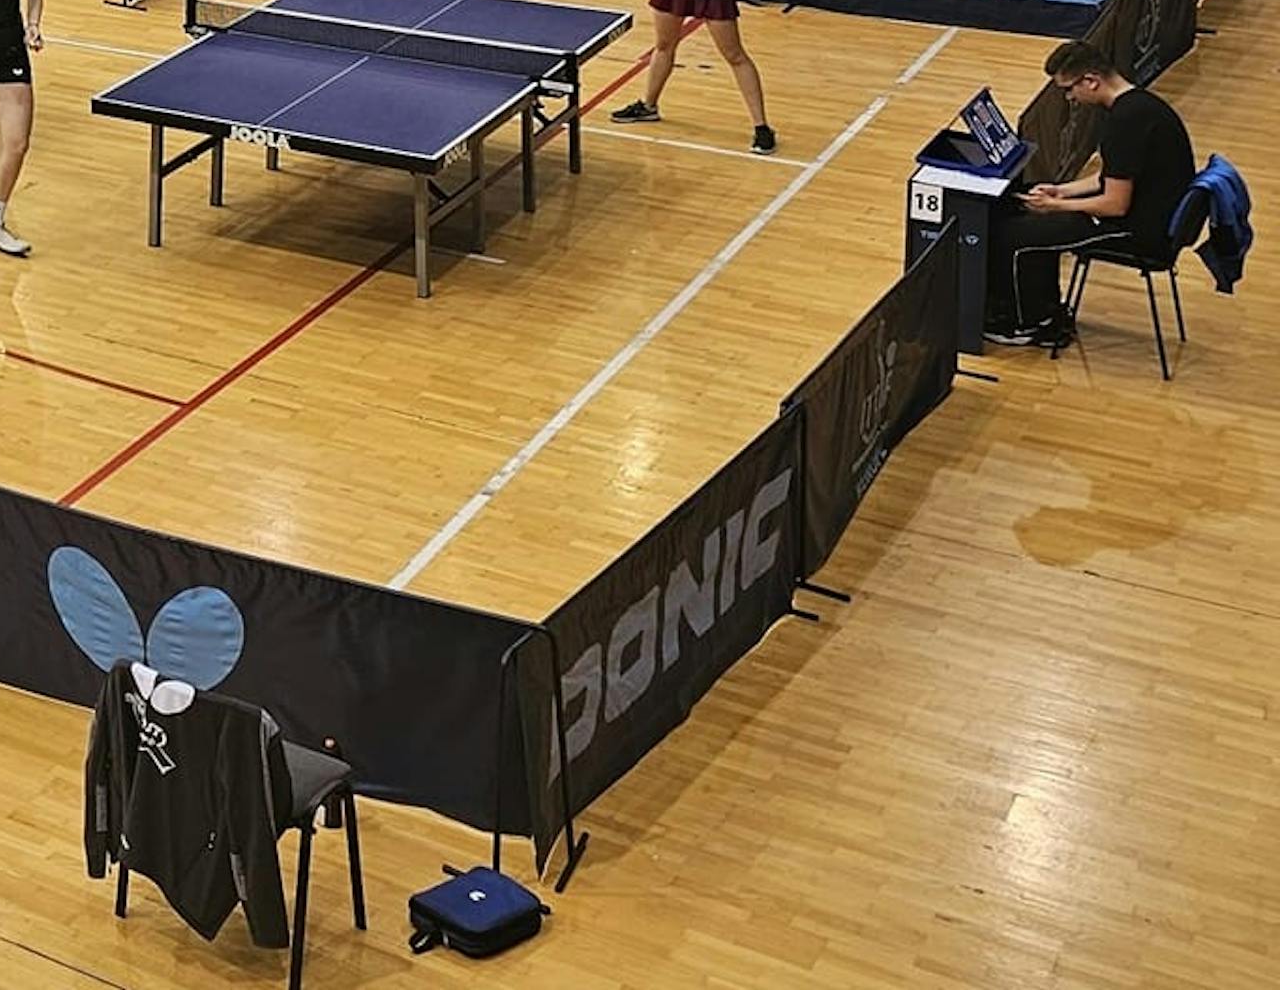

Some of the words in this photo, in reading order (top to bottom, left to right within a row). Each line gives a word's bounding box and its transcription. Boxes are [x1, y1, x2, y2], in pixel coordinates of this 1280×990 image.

[229, 124, 288, 150] JOOLA
[914, 193, 939, 211] 18
[548, 468, 793, 790] DONIC
